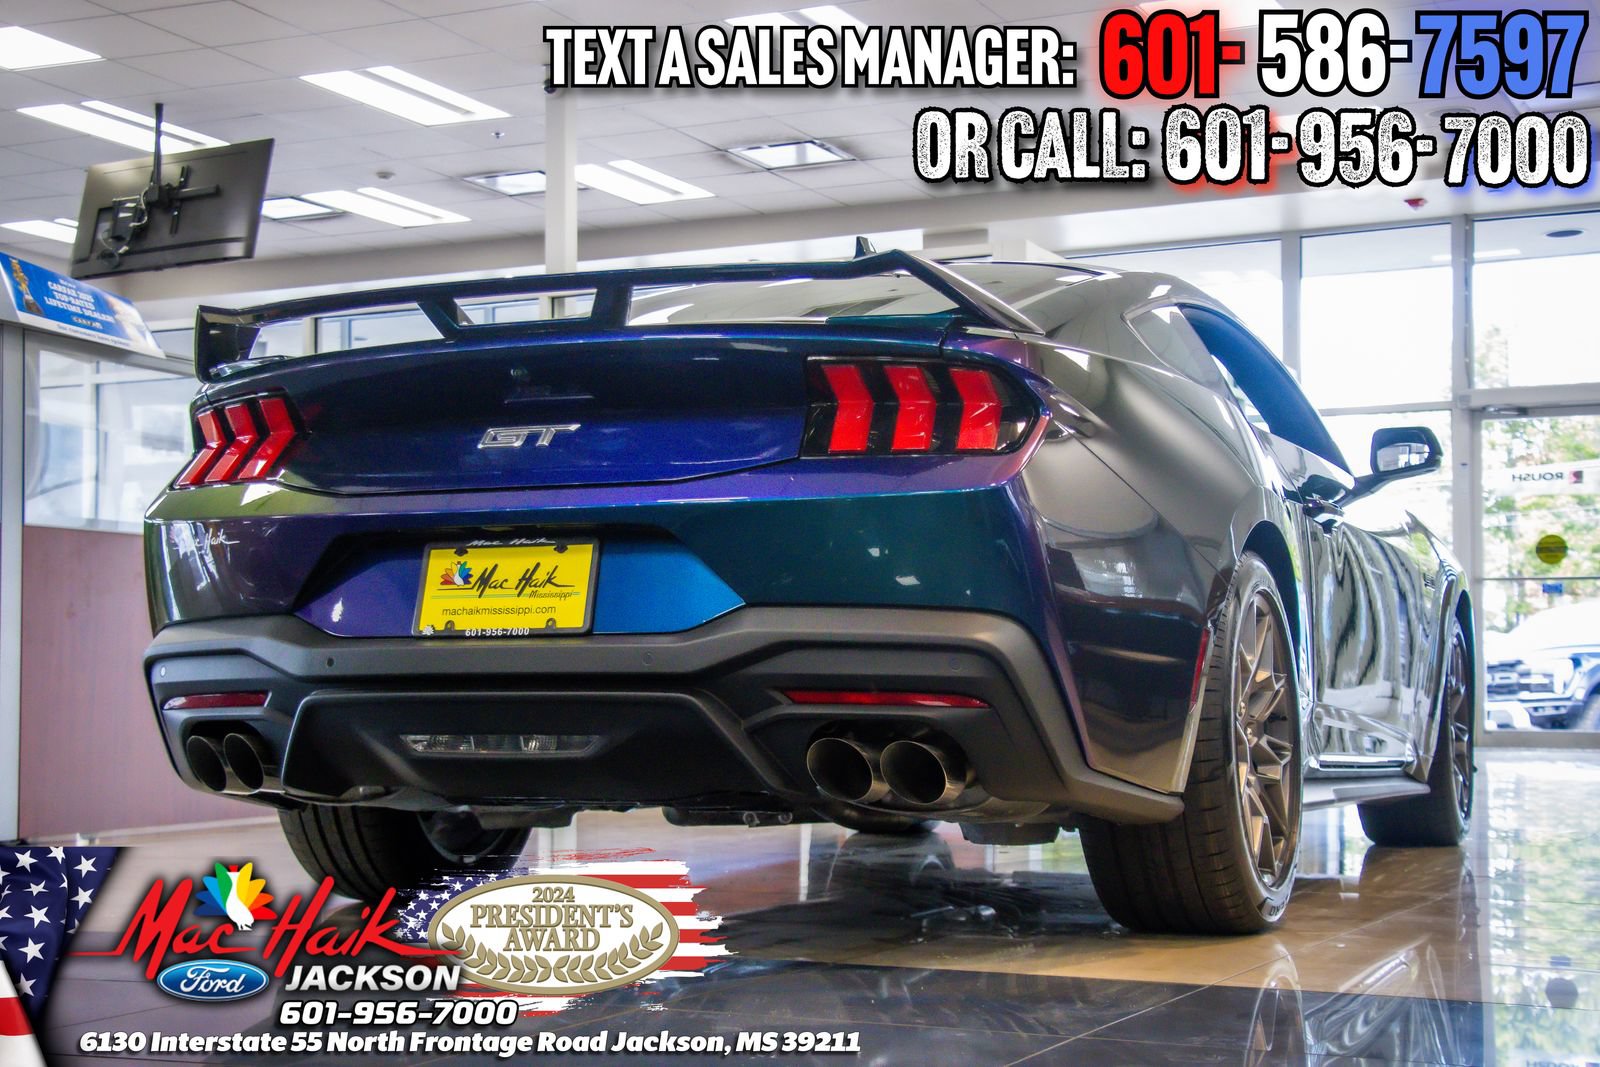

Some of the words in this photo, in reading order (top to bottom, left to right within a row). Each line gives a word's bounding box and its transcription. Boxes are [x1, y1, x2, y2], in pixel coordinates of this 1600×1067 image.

[43, 295, 83, 314] LIFETIME
[477, 423, 581, 449] GT
[437, 563, 514, 598] Mac
[515, 562, 575, 598] Haik
[528, 589, 573, 600] Mississippi
[441, 605, 557, 618] machaikmississippi.com
[465, 627, 530, 637] 601-956-7000
